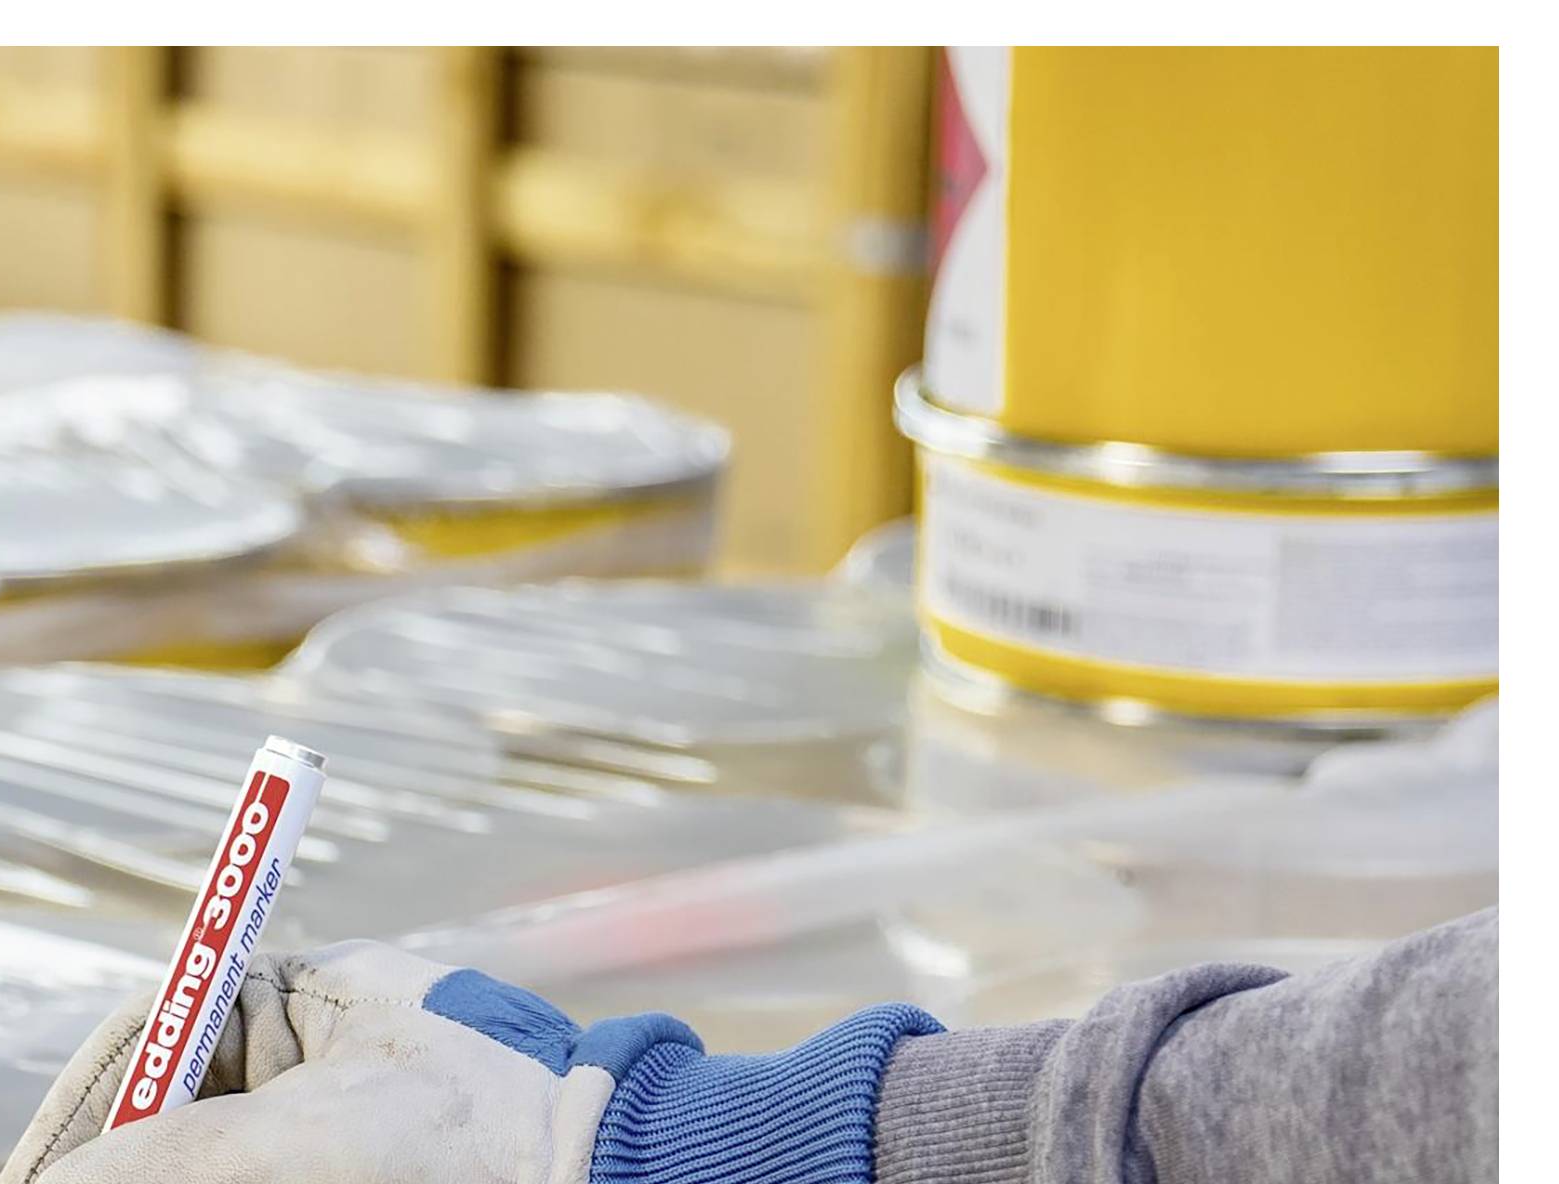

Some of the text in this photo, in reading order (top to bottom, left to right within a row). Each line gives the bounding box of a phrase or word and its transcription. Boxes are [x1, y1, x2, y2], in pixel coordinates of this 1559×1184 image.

[203, 801, 270, 931] 3000
[183, 858, 281, 1097] permanent marker
